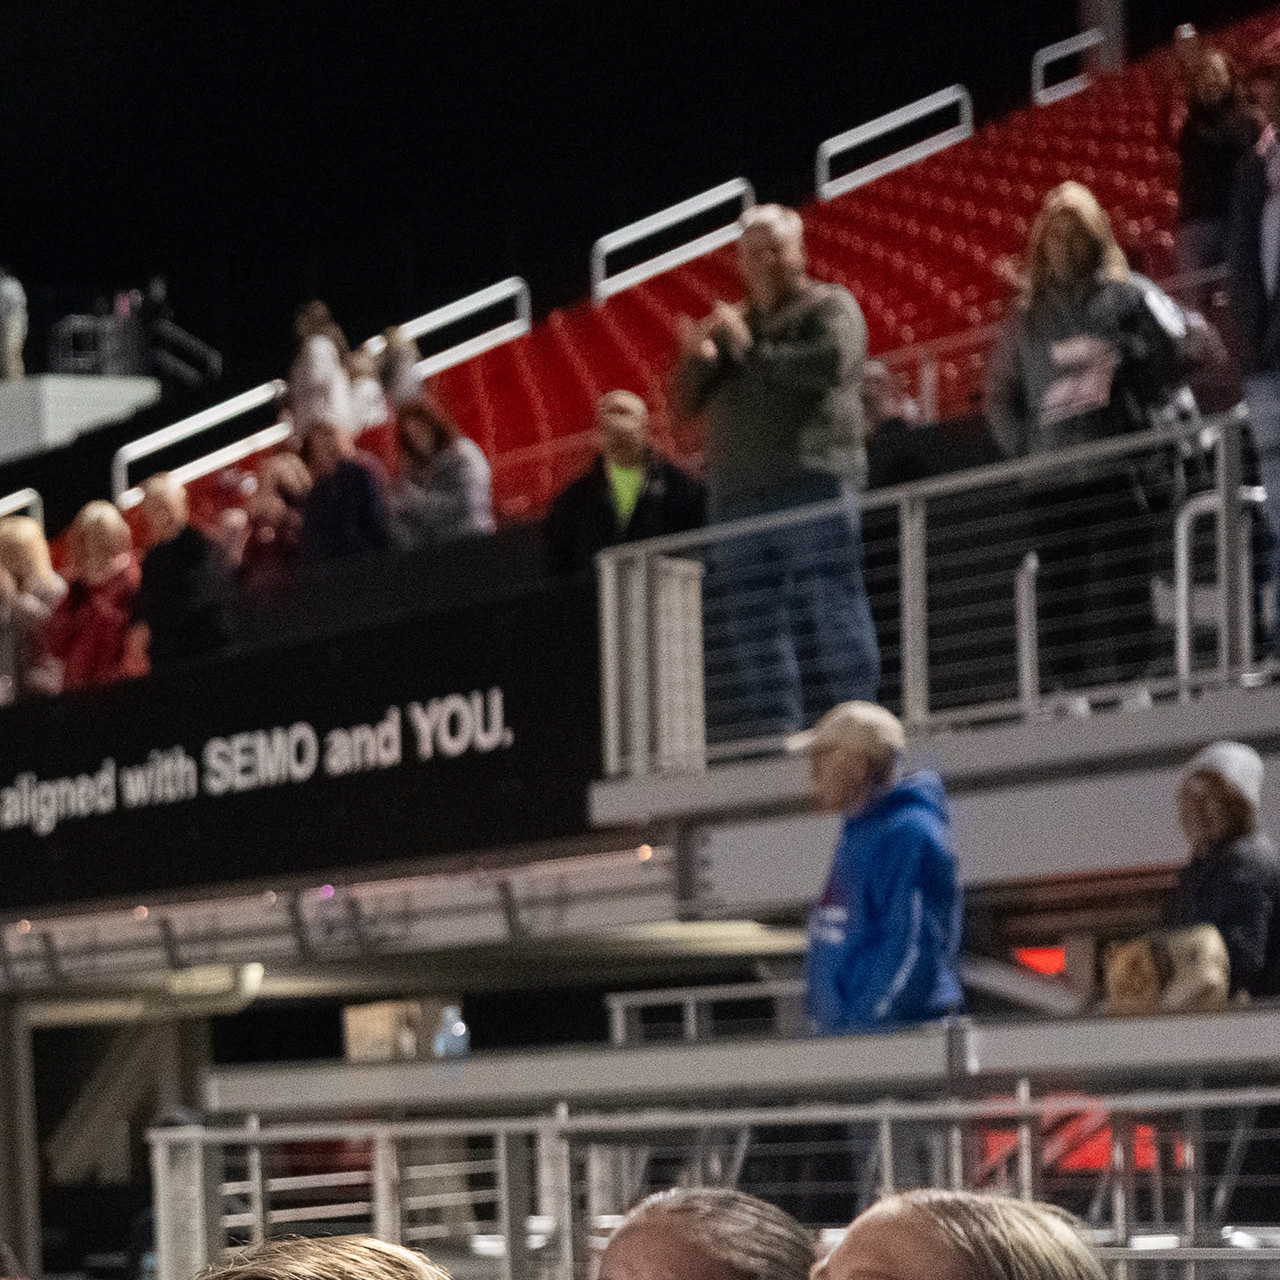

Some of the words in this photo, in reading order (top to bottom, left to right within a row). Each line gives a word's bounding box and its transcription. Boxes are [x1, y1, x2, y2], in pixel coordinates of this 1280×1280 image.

[118, 744, 198, 808] with
[202, 720, 320, 796] SEMO
[323, 704, 403, 776] and
[408, 686, 515, 760] YOU.
